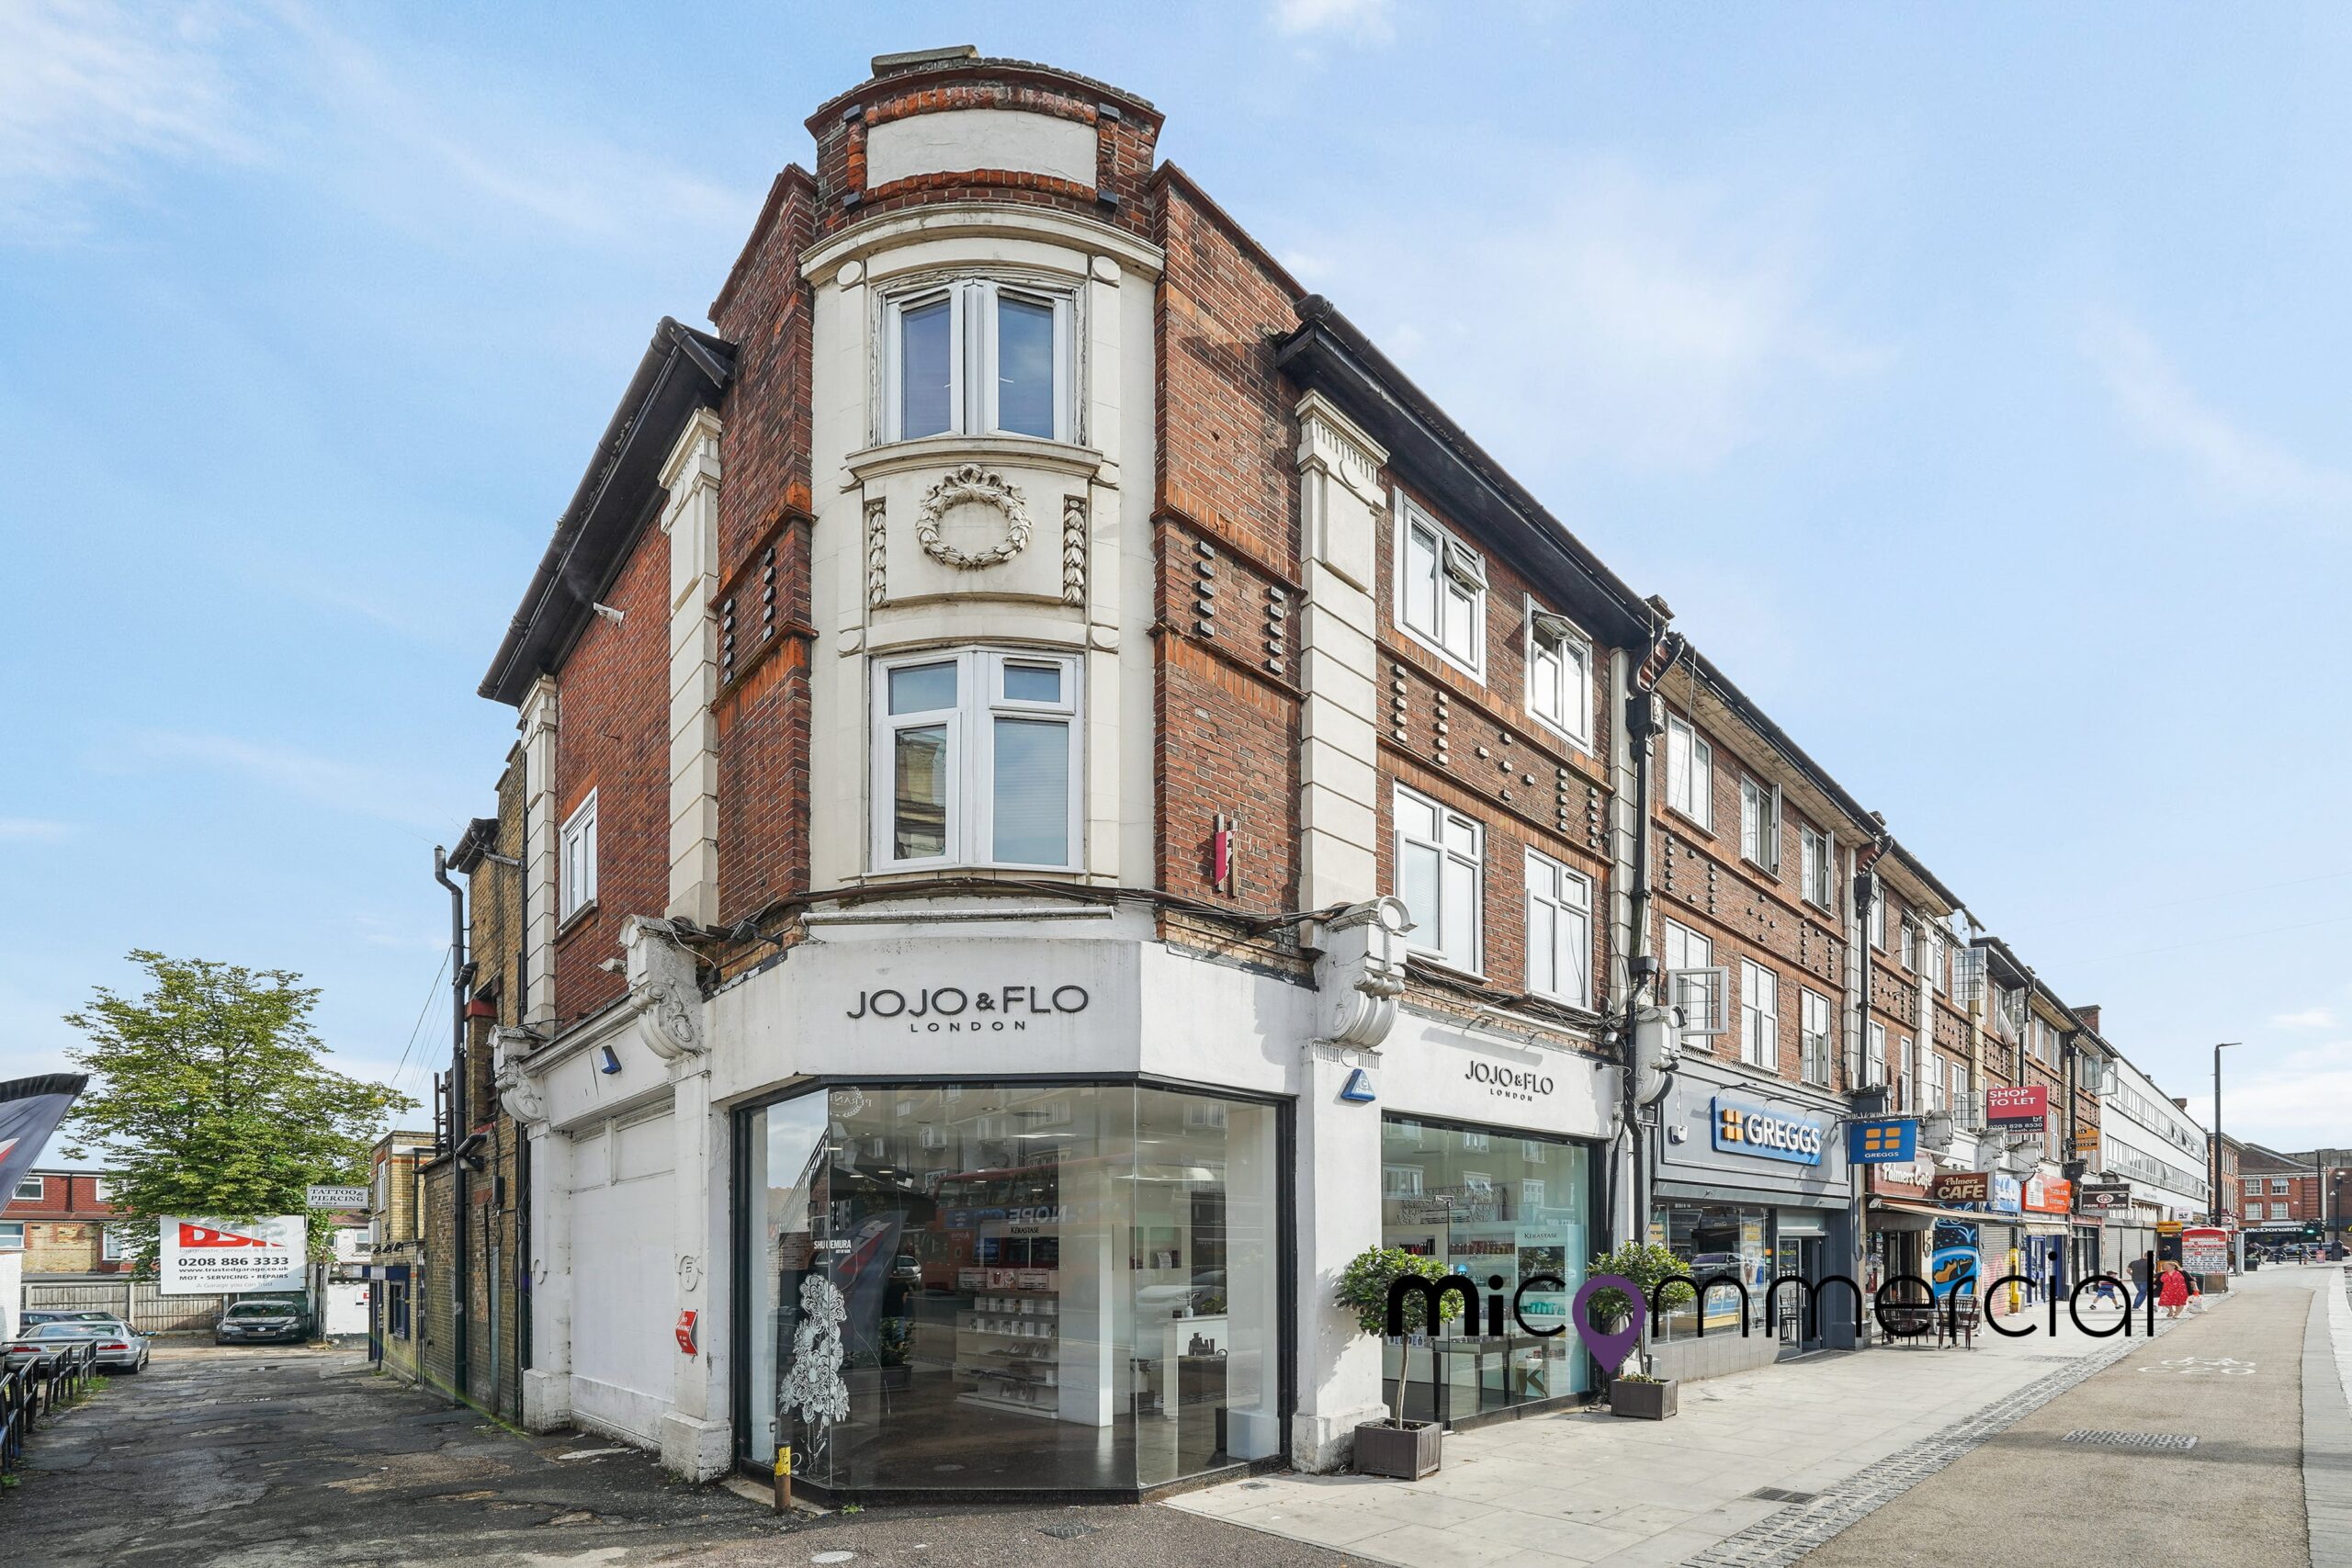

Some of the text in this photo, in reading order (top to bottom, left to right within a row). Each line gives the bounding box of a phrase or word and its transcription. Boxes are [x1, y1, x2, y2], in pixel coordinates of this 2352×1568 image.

[910, 1021, 1025, 1032] LONDON
[1490, 1089, 1532, 1102] LONDON
[1989, 1089, 2029, 1099] SHOP
[1989, 1097, 2036, 1107] TO LET
[1746, 1113, 1821, 1154] GREGGS
[1882, 1162, 1915, 1185] Palmers
[1944, 1177, 1978, 1185] Palmers
[1937, 1184, 1985, 1200] CAFE
[178, 1257, 289, 1267] 0208 886 3333
